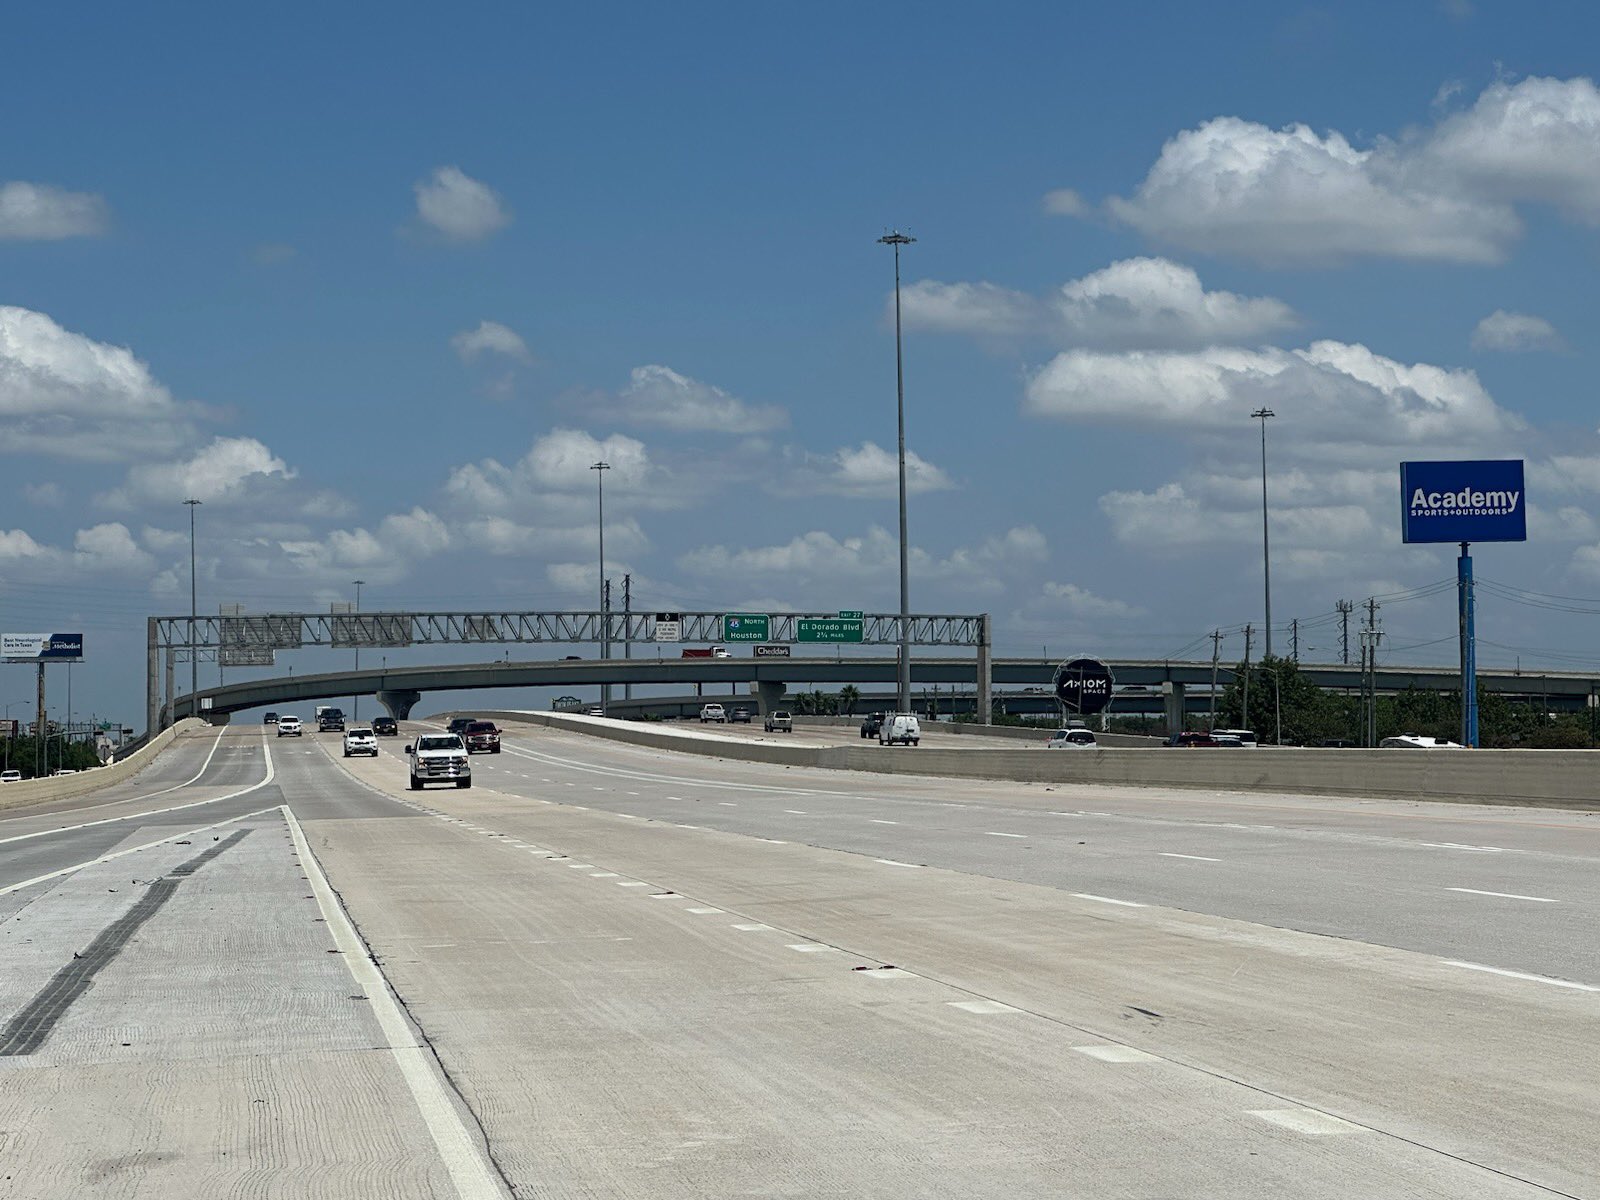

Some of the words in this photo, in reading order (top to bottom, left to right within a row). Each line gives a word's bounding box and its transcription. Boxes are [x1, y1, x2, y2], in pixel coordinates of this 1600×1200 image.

[1411, 487, 1520, 513] Academy
[730, 620, 740, 628] 45
[1063, 679, 1106, 688] AXIOM
